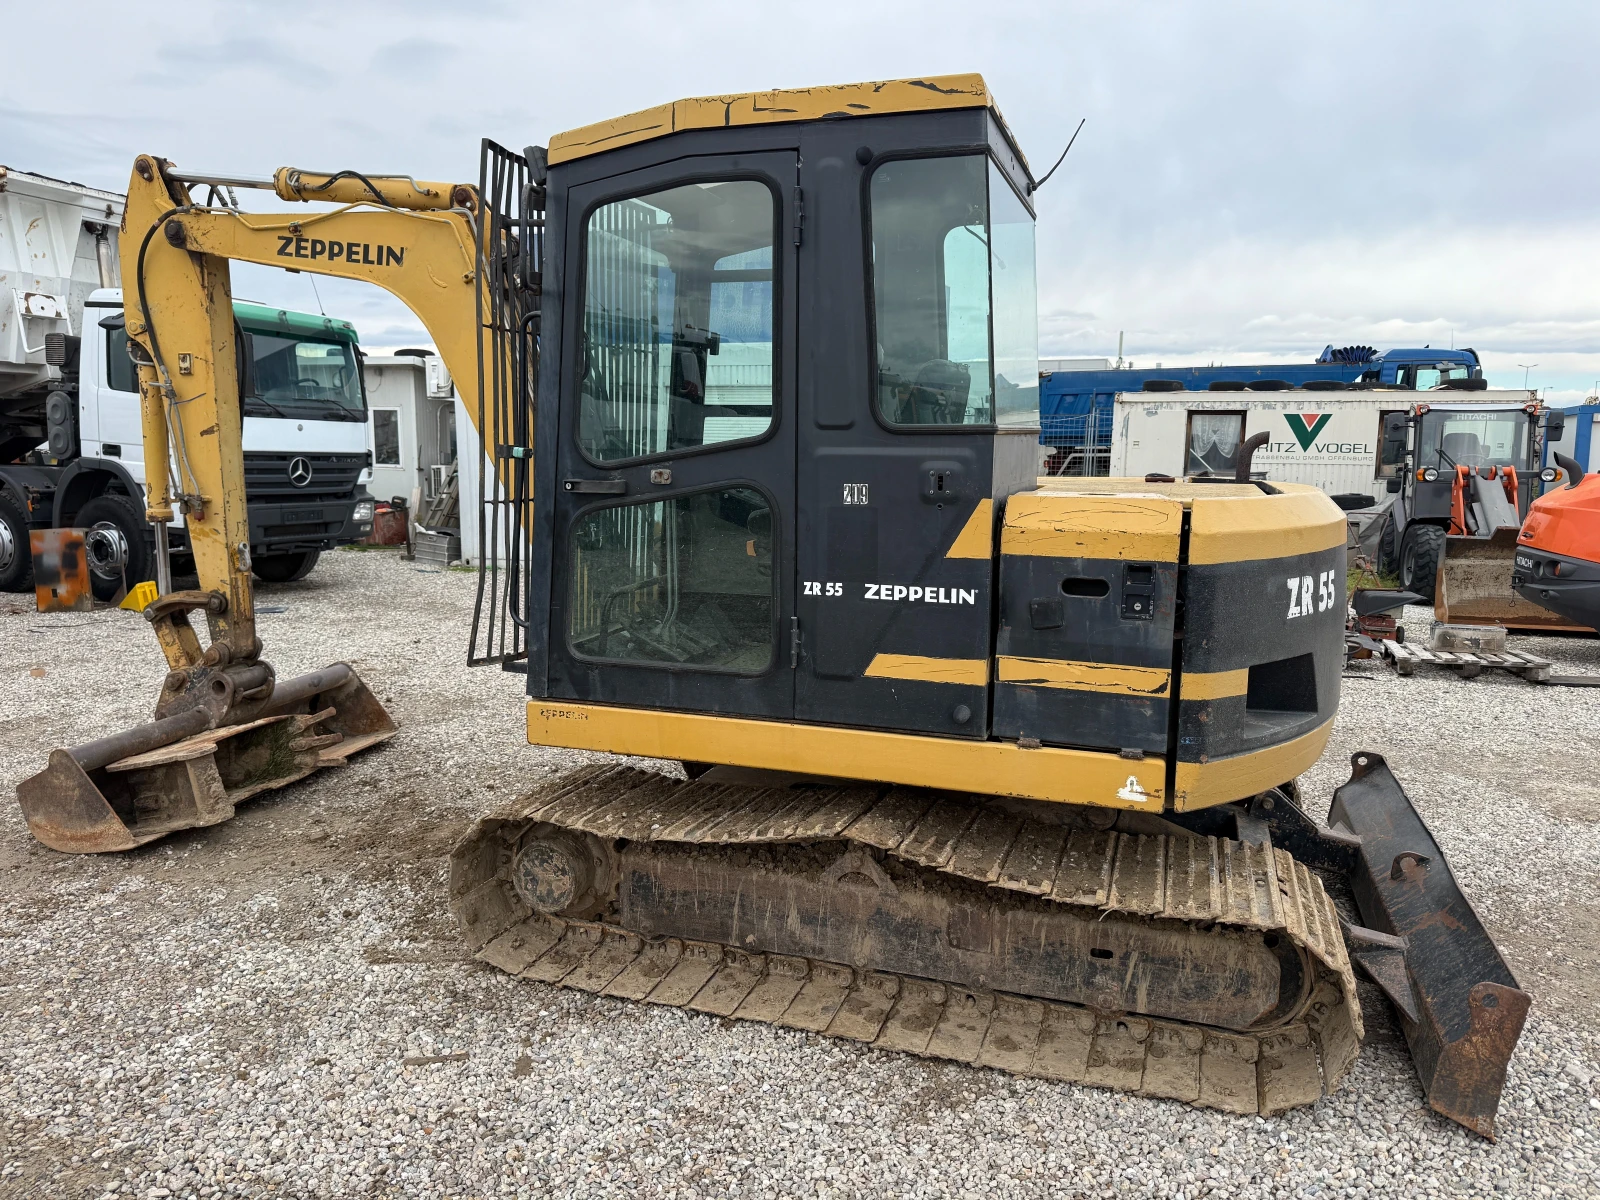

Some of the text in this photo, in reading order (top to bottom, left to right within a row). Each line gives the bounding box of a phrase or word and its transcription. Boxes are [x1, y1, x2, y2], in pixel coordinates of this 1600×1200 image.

[277, 235, 405, 268] ZEPPELIN
[1456, 413, 1497, 421] HITACHI
[1256, 442, 1374, 454] RITZ VOGEL
[843, 483, 869, 505] 209
[1516, 555, 1534, 569] HITACHI
[803, 581, 843, 597] ZR 55
[864, 583, 976, 605] ZEPPELIN
[1286, 569, 1335, 620] ZR 55
